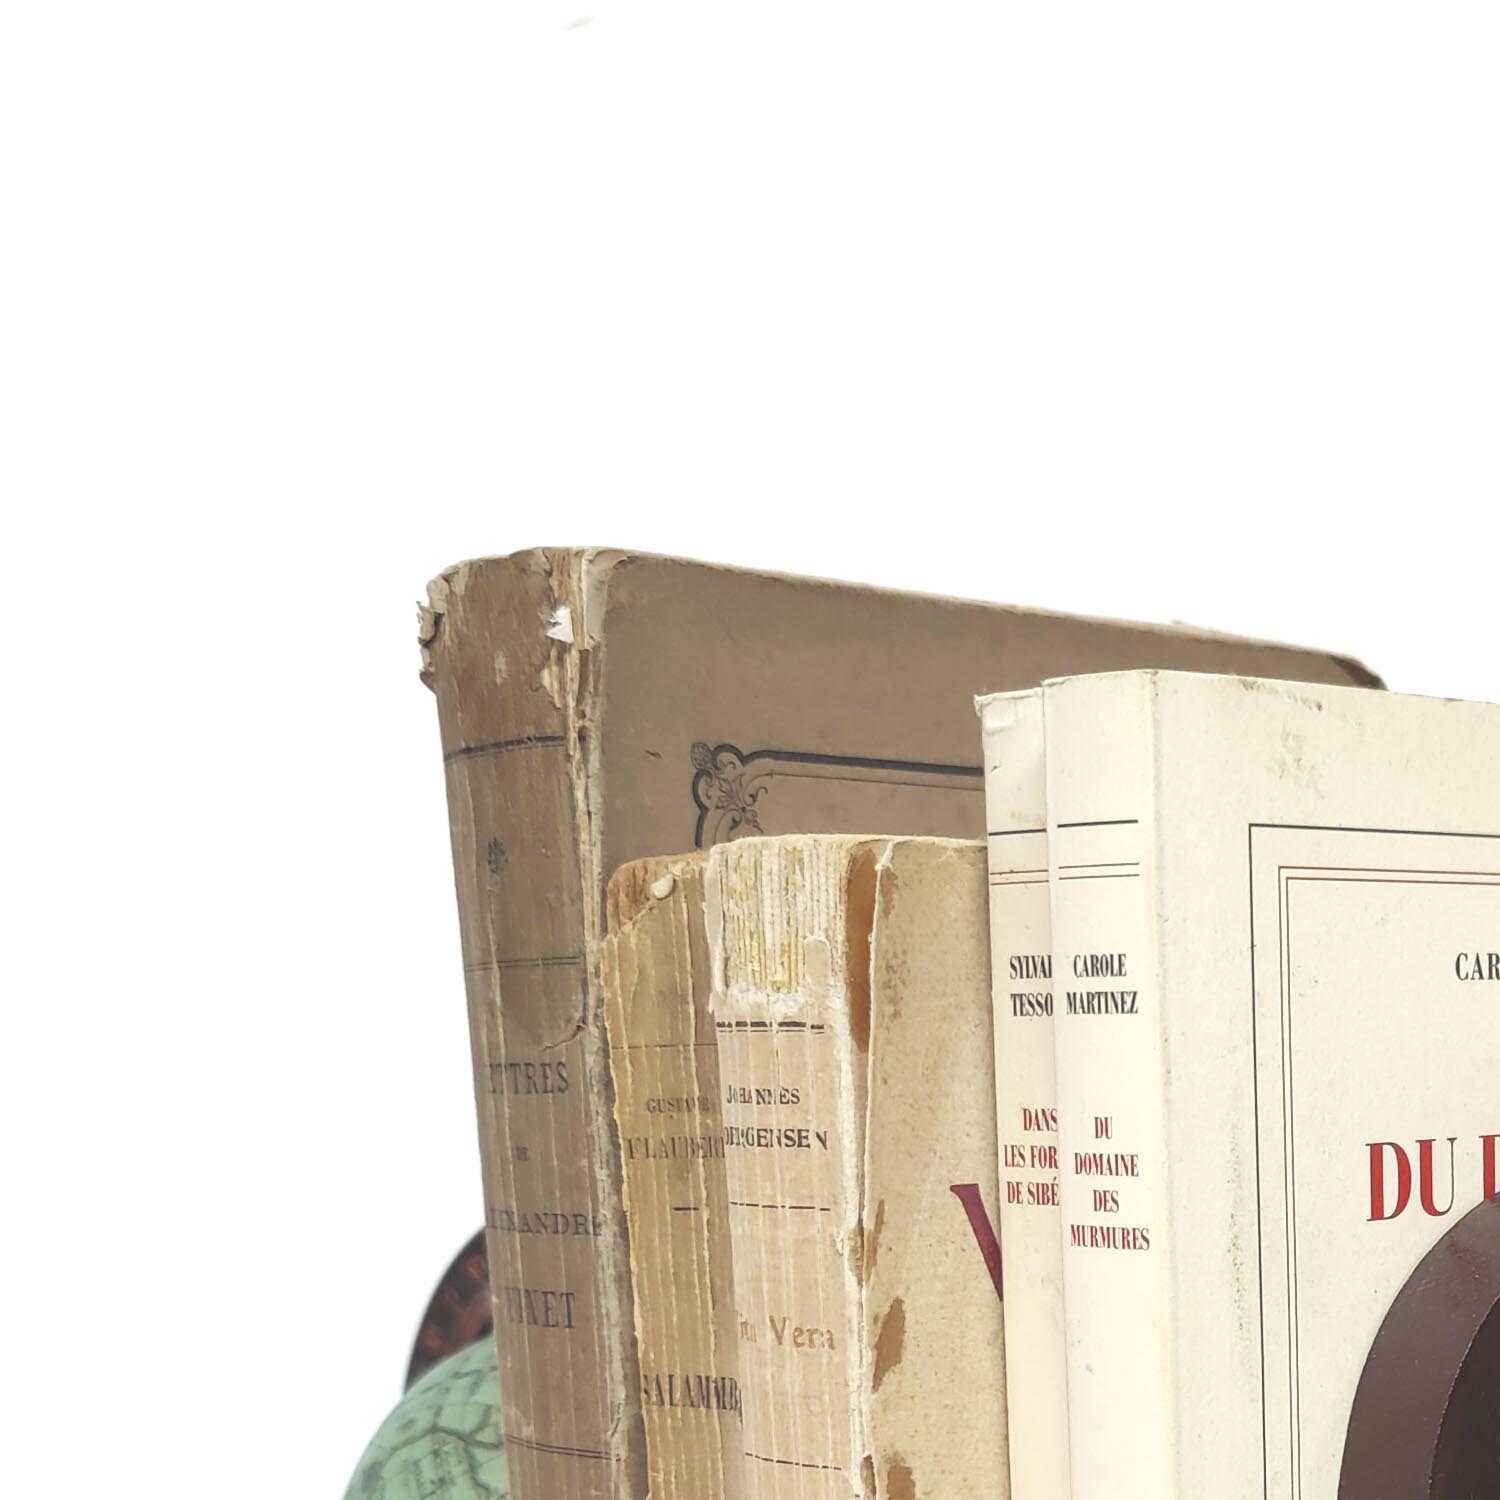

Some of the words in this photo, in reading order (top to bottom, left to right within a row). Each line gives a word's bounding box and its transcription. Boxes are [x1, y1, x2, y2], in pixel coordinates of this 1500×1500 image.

[1009, 954, 1052, 980] SYLVAI
[1073, 953, 1127, 978] CAROLE
[1010, 993, 1054, 1017] TESSO
[1066, 991, 1139, 1016] MARTINEZ
[1022, 1107, 1058, 1133] DANS
[1094, 1116, 1114, 1140] DU
[1004, 1144, 1026, 1168] LES
[1031, 1145, 1060, 1170] FOR
[1074, 1152, 1139, 1178] DOMAINE
[1007, 1181, 1024, 1206] DE
[1027, 1177, 1060, 1206] SIBÉ
[1365, 1137, 1458, 1222] DU
[1093, 1189, 1119, 1214] DES
[1070, 1224, 1150, 1251] MURMURES
[769, 1314, 836, 1351] Vera
[641, 1374, 743, 1412] SALAMMB
